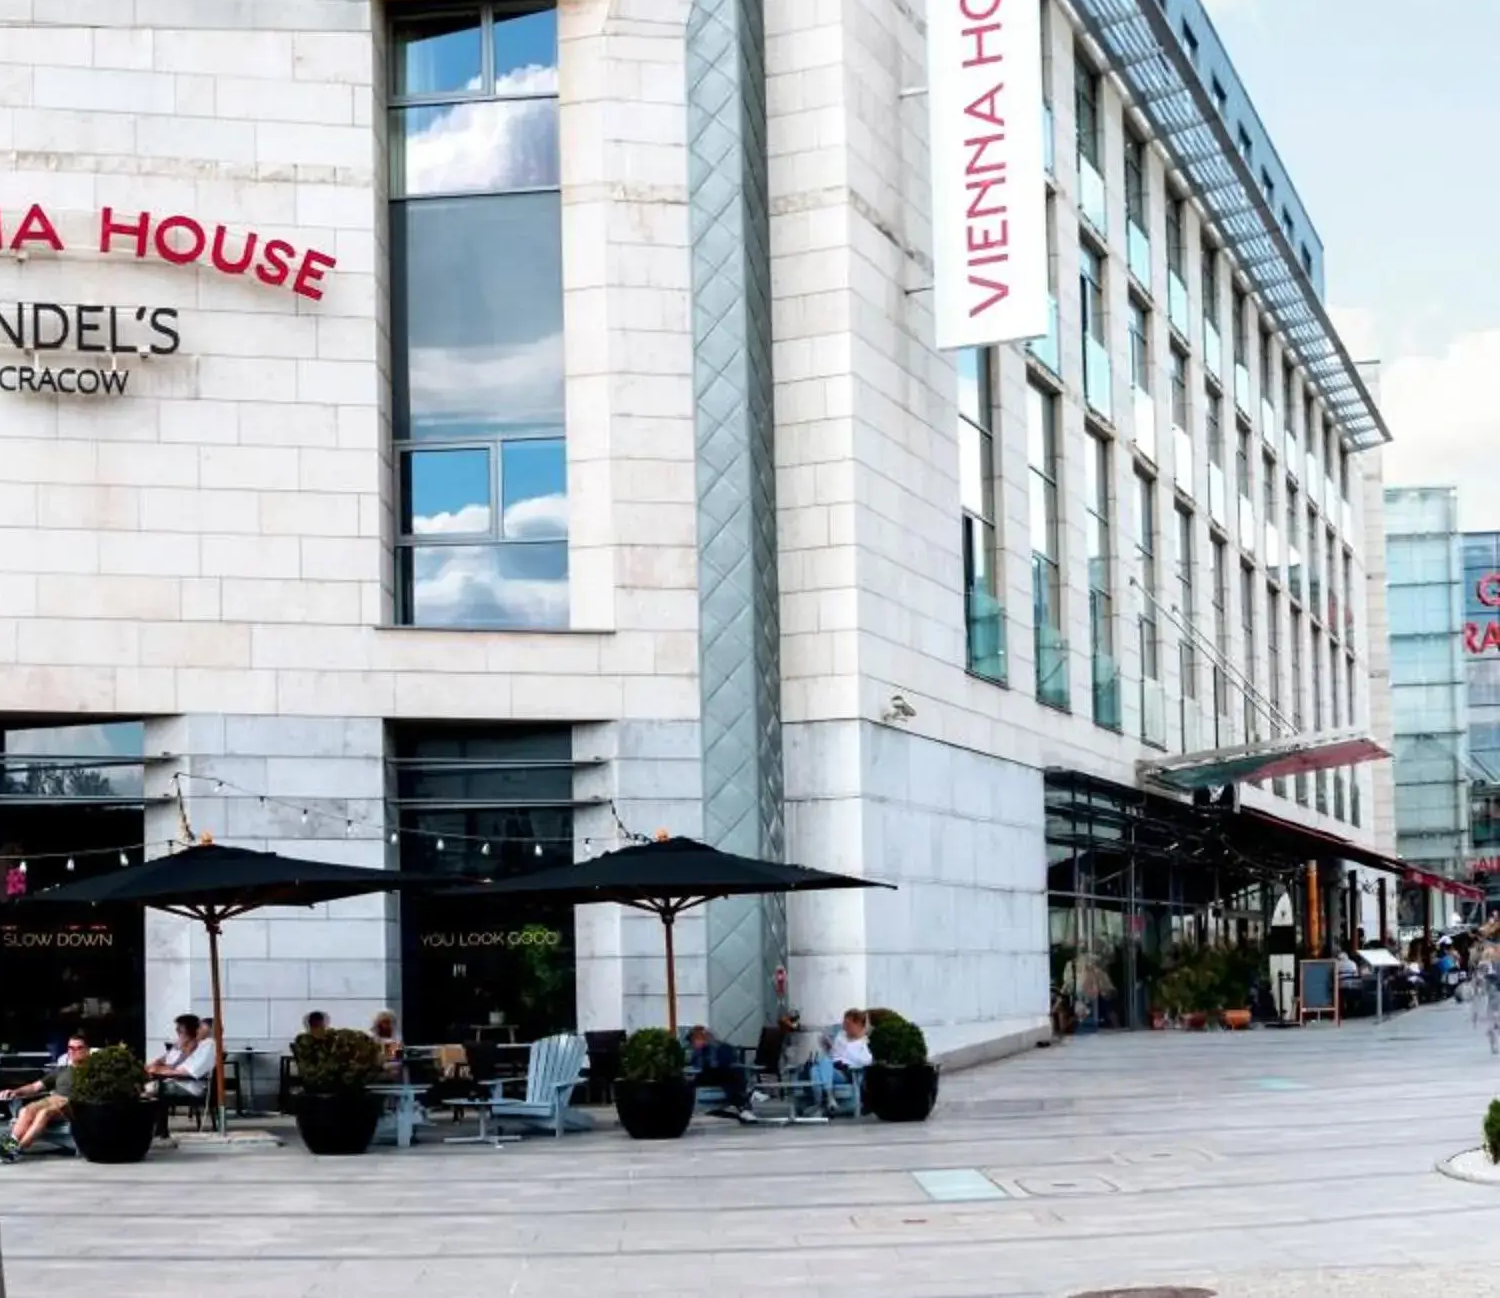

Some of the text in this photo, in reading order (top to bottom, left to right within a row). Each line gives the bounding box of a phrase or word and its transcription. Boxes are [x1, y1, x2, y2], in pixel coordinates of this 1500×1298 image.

[964, 82, 1010, 318] VIENNA
[100, 206, 337, 301] HOUSE
[3, 932, 113, 947] SLOW DOWN
[420, 931, 455, 947] YOU
[459, 931, 504, 947] LOOK
